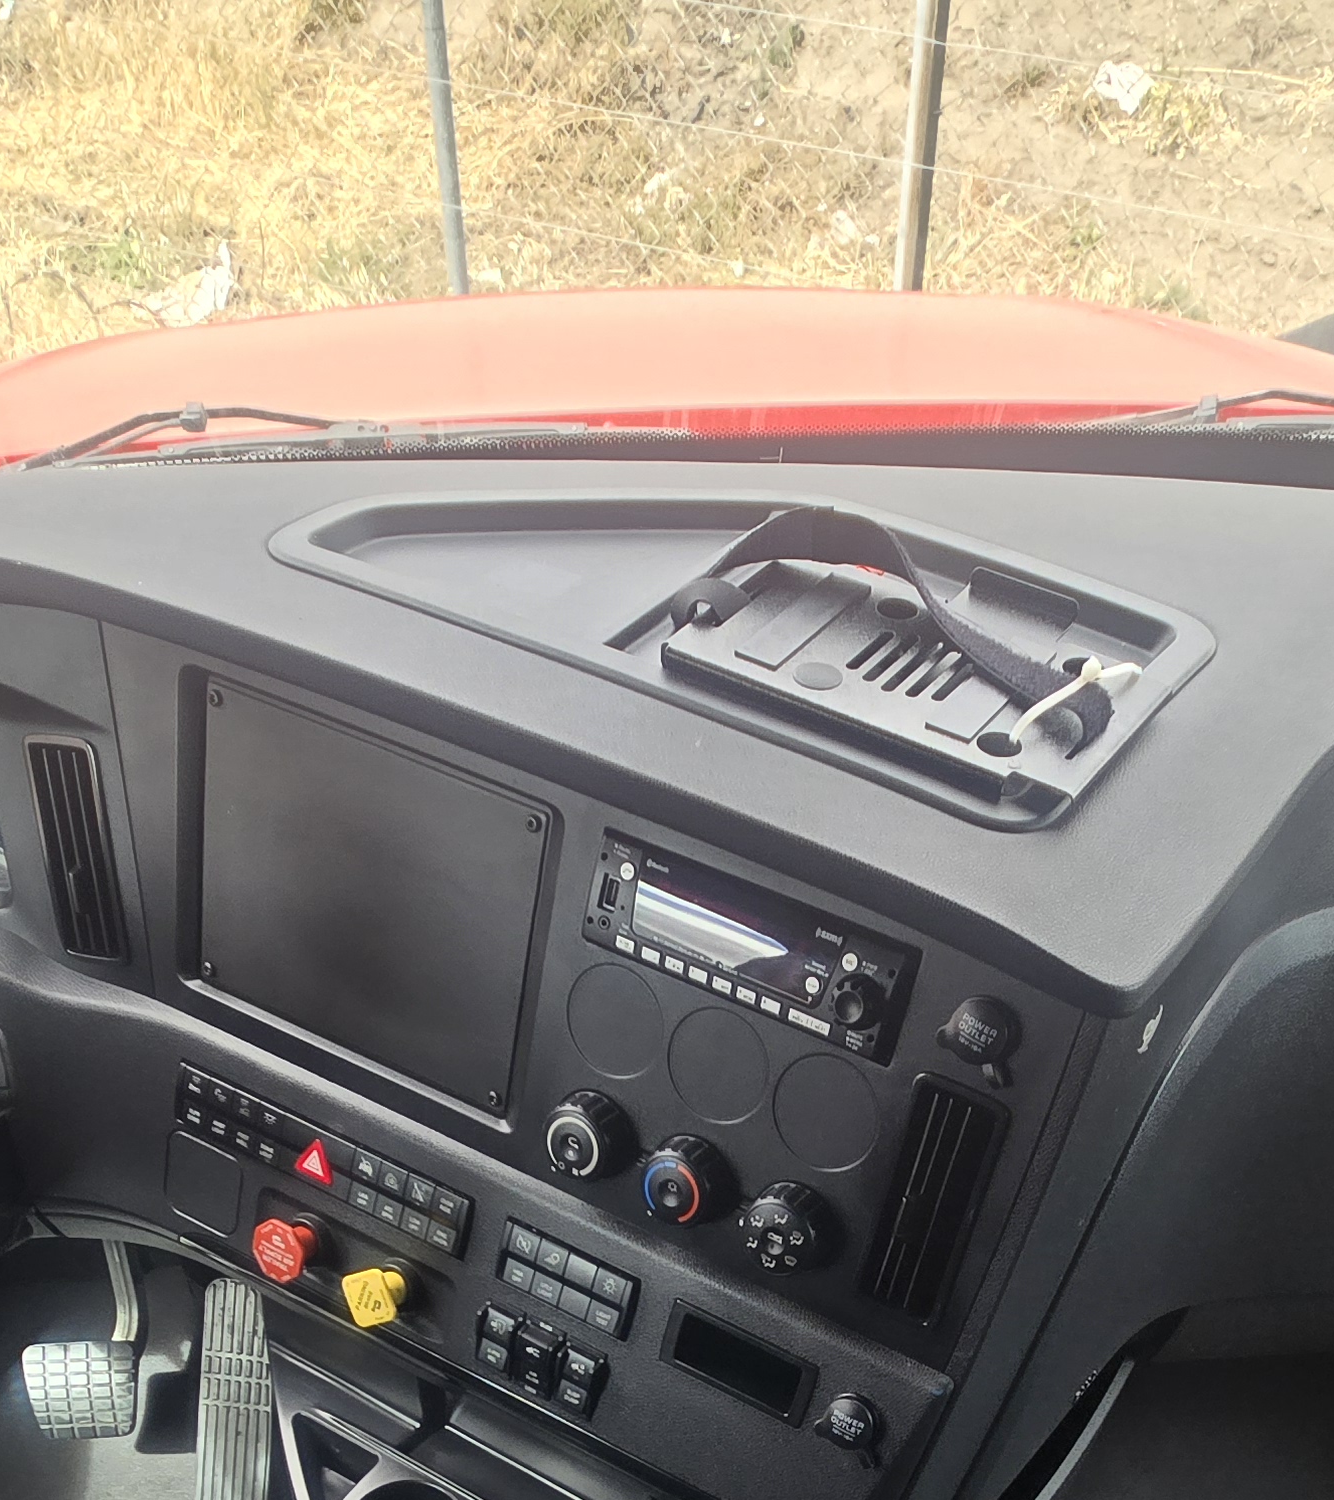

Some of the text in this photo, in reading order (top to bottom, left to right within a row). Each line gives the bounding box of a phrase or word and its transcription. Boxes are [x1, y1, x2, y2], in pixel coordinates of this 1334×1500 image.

[958, 1021, 994, 1045] OUTLET
[962, 1012, 998, 1038] POWER
[355, 1281, 369, 1311] PARKING
[830, 1415, 862, 1435] OUTLET
[833, 1409, 865, 1429] POWER
